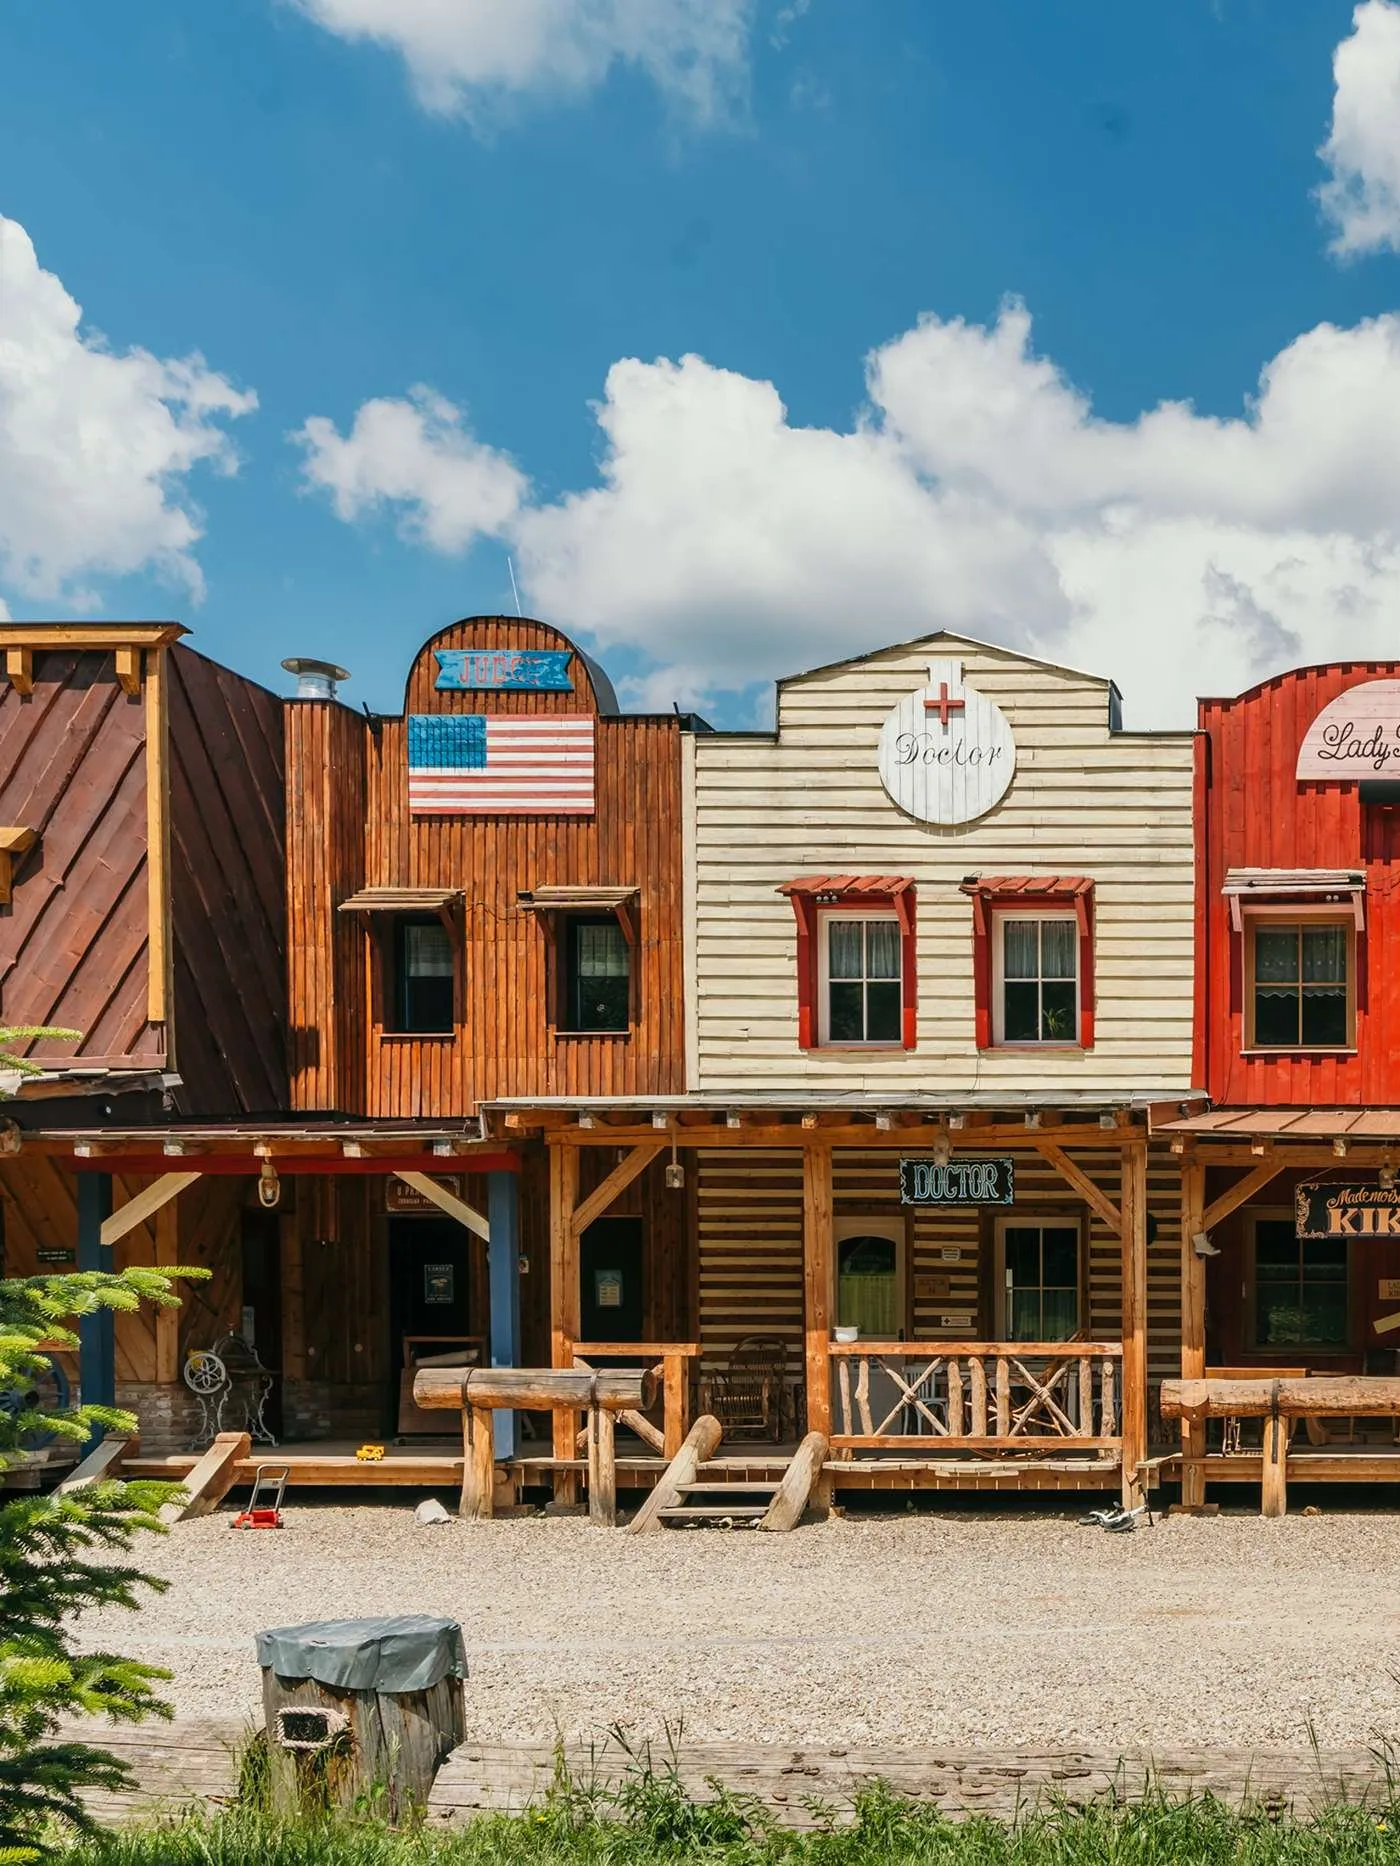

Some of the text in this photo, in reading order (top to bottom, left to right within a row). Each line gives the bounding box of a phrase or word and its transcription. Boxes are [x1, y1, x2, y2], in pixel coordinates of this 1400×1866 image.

[894, 733, 1001, 766] Doctor
[1318, 722, 1390, 770] Lady
[914, 1164, 999, 1199] DOCTOR
